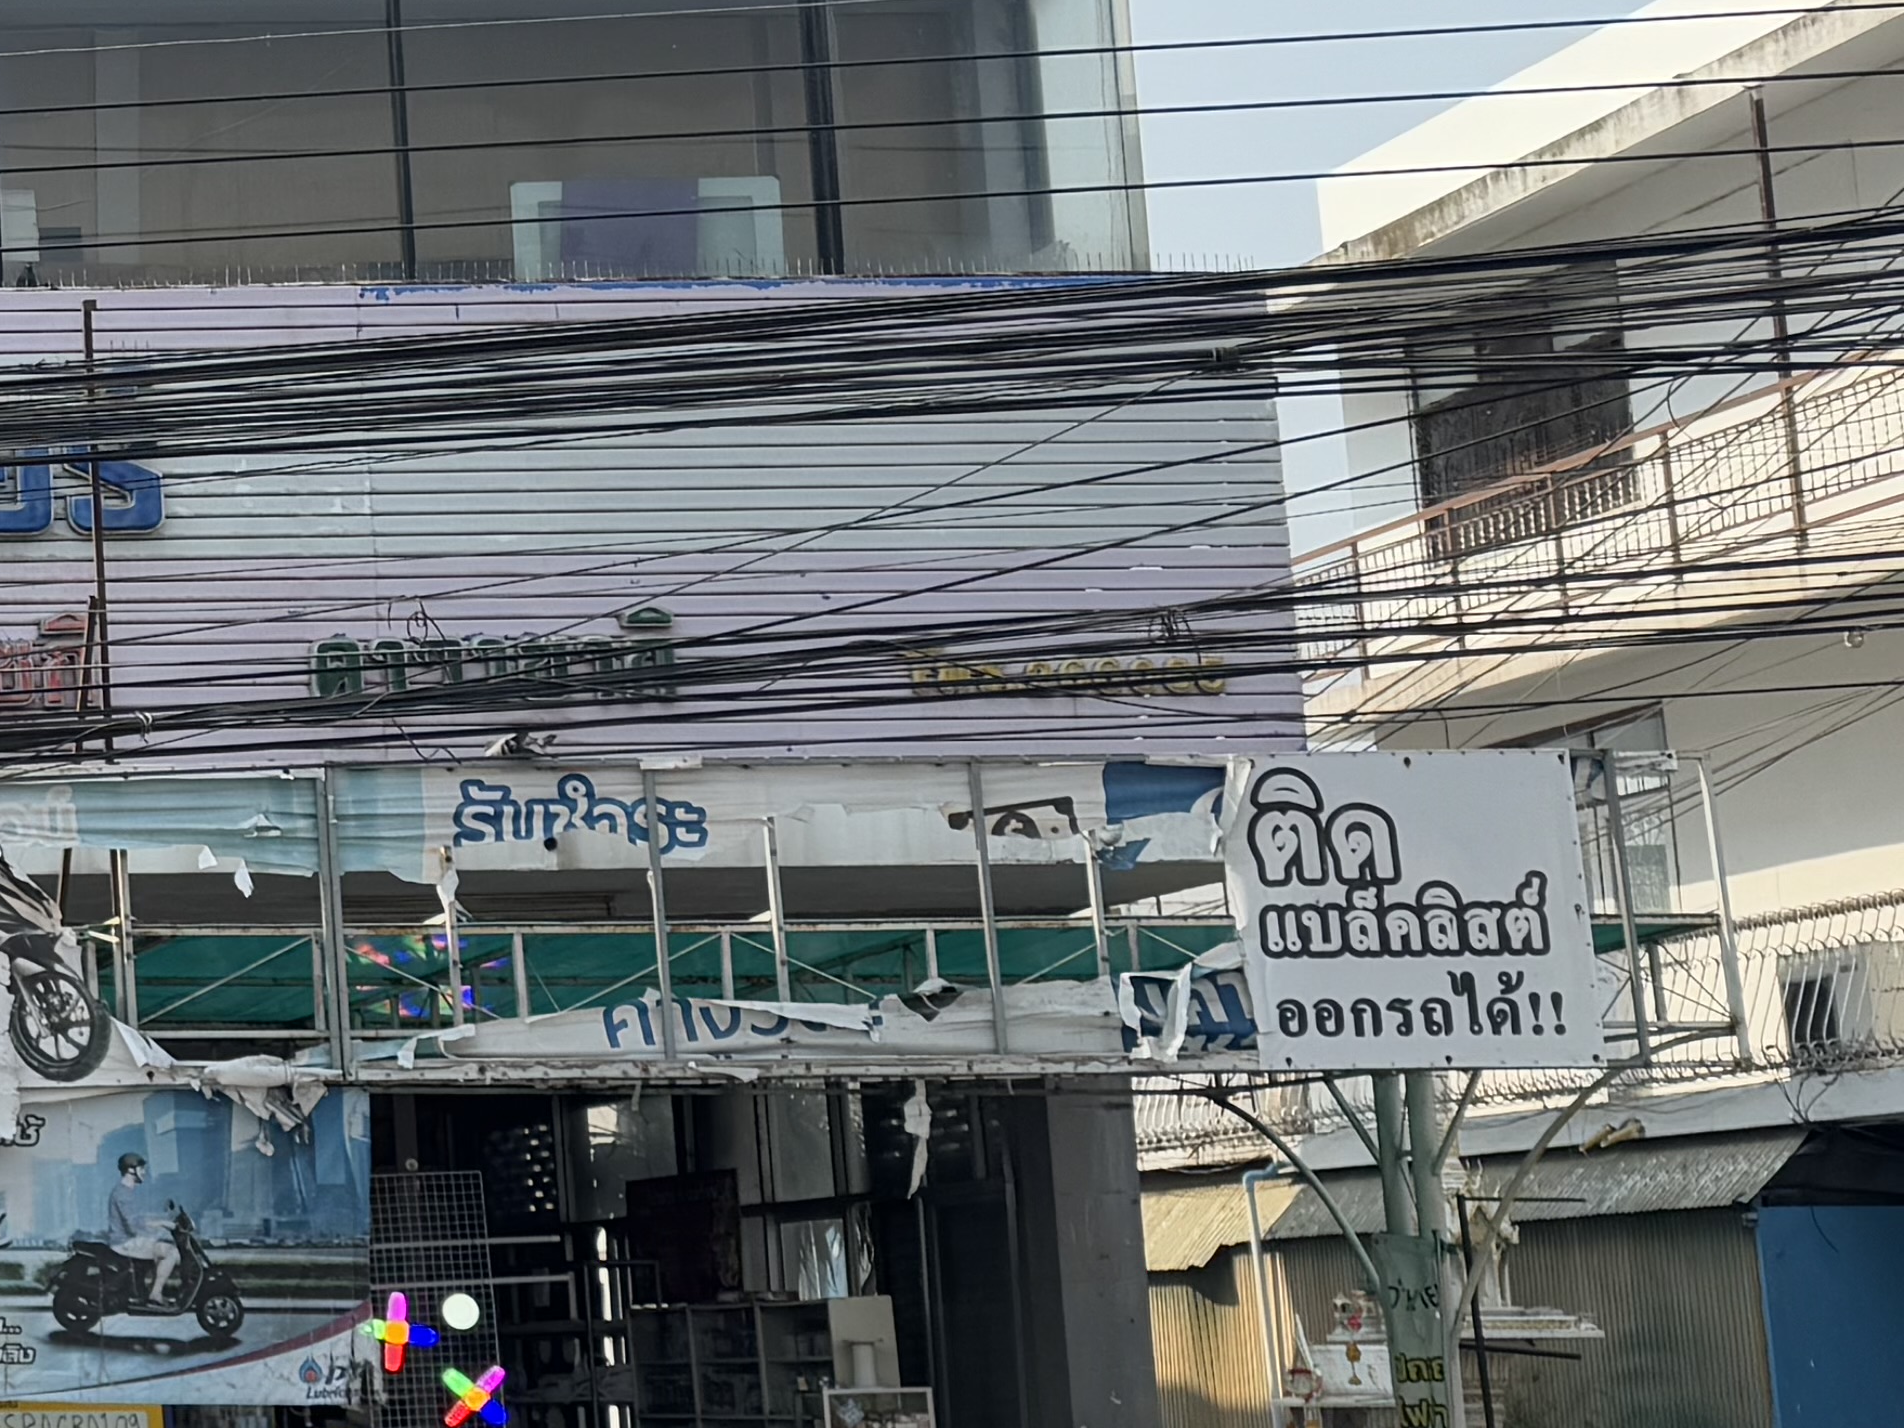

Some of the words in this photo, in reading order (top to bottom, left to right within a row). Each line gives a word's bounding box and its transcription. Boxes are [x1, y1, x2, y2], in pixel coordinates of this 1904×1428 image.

[1248, 767, 1402, 887] ติด
[1259, 870, 1550, 959] แบล็คลิสต์
[1277, 970, 1566, 1036] ออกรถได้!!
